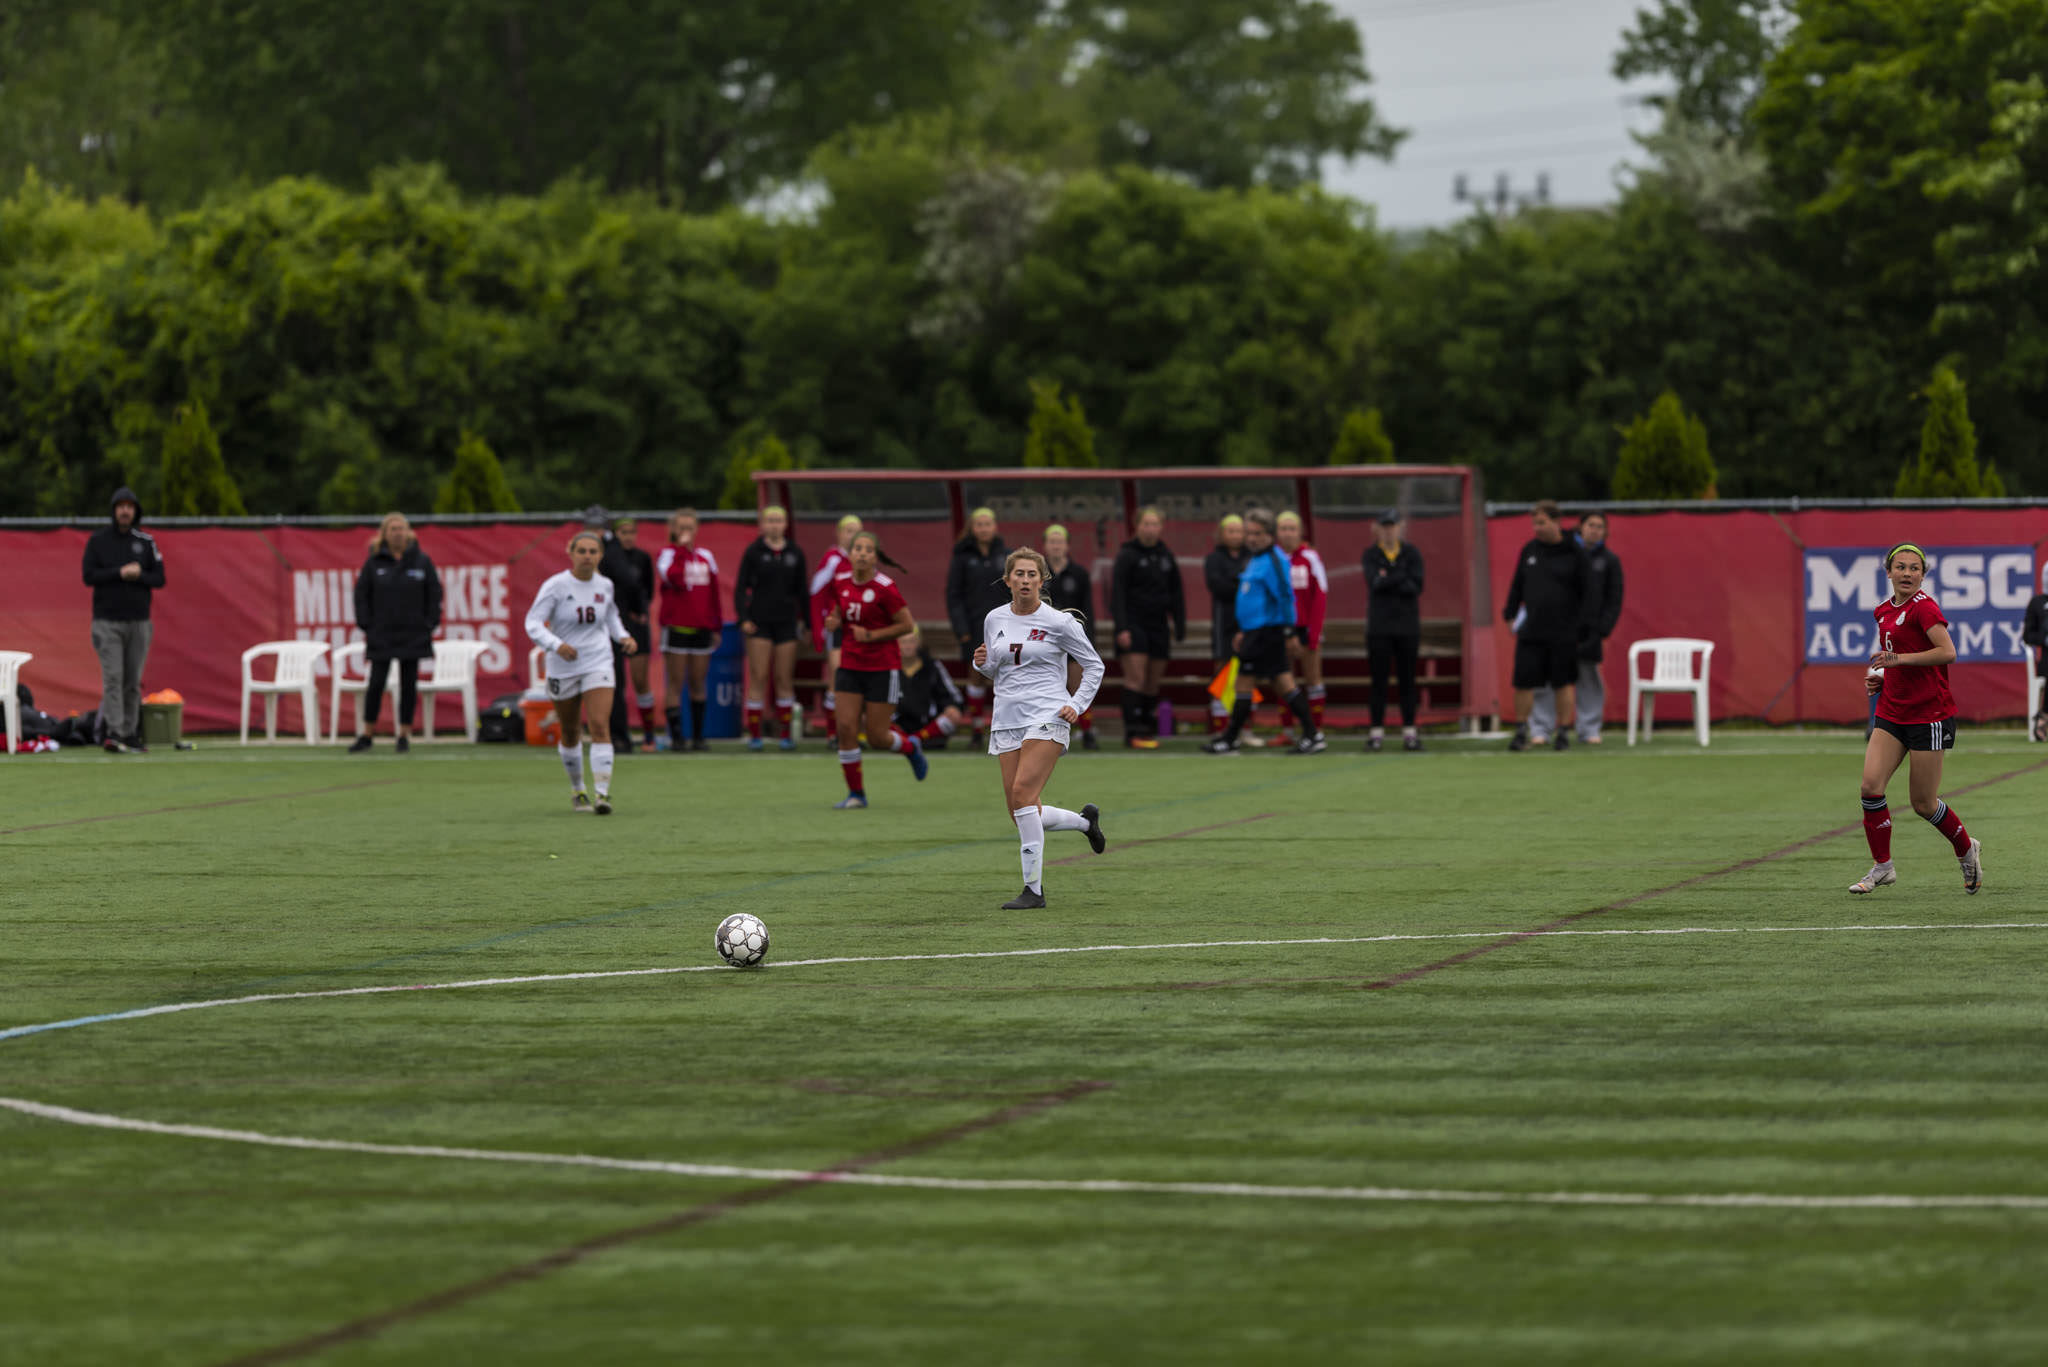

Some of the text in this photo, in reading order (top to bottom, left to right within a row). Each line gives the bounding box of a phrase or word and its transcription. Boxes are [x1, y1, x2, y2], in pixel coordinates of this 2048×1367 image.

[294, 564, 509, 625] MILKEE
[846, 602, 862, 621] 21
[1808, 622, 2026, 656] ACMY
[1885, 631, 1893, 652] 6
[1009, 643, 1023, 665] 7
